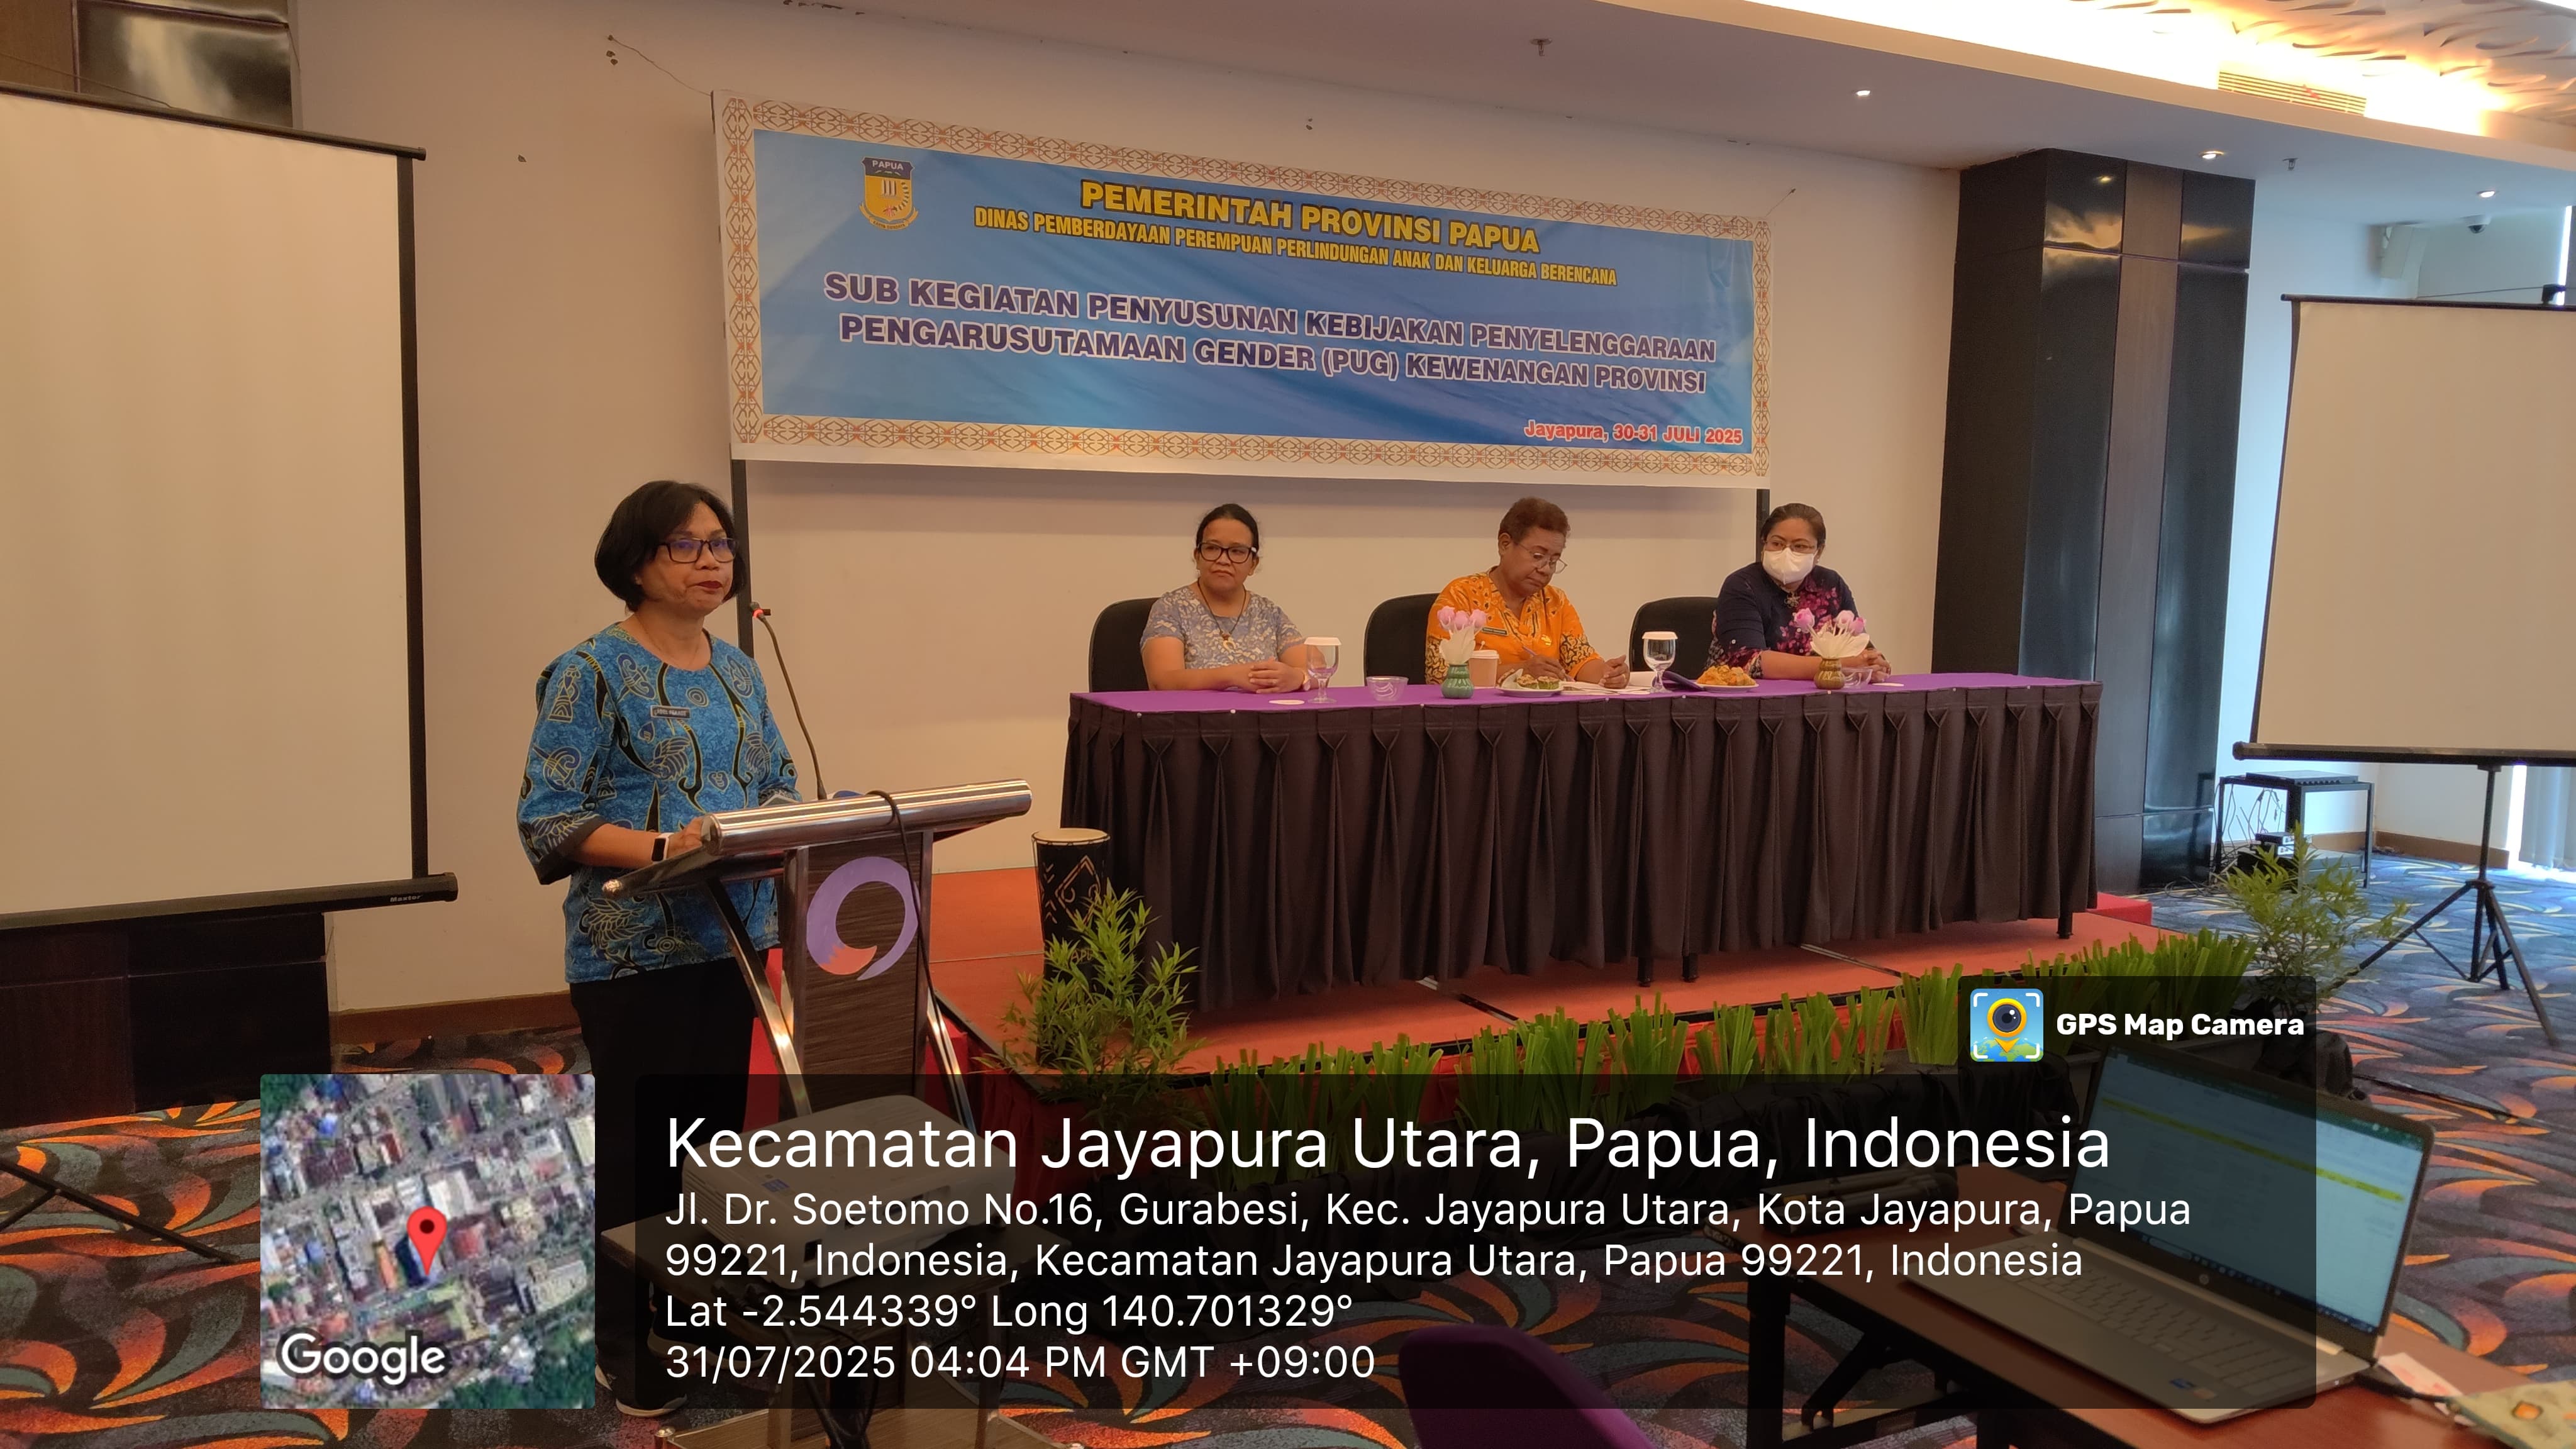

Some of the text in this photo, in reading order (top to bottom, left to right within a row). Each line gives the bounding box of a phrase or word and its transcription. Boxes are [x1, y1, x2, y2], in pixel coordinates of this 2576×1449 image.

[872, 160, 904, 170] PAPUA
[975, 206, 1618, 286] DINAS PEMBERDAYAAN PEREMPUAN PERLINDUNGAN ANAK DAN KELUARGA BERENCANA
[1081, 180, 1540, 252] PEMERINTAH PROVINSI PAPUA
[824, 272, 1716, 362] SUB KEGIATAN PENYUSUNAN KEBIJAKAN PENYELENGGARAAN
[840, 313, 1706, 393] PENGARUSUTAMAAN GENDER (PUG) KEWENANGAN PROVINSI
[1523, 419, 1742, 445] Jayapura, 30-31 JULI 2025
[389, 894, 423, 902] Maxtor
